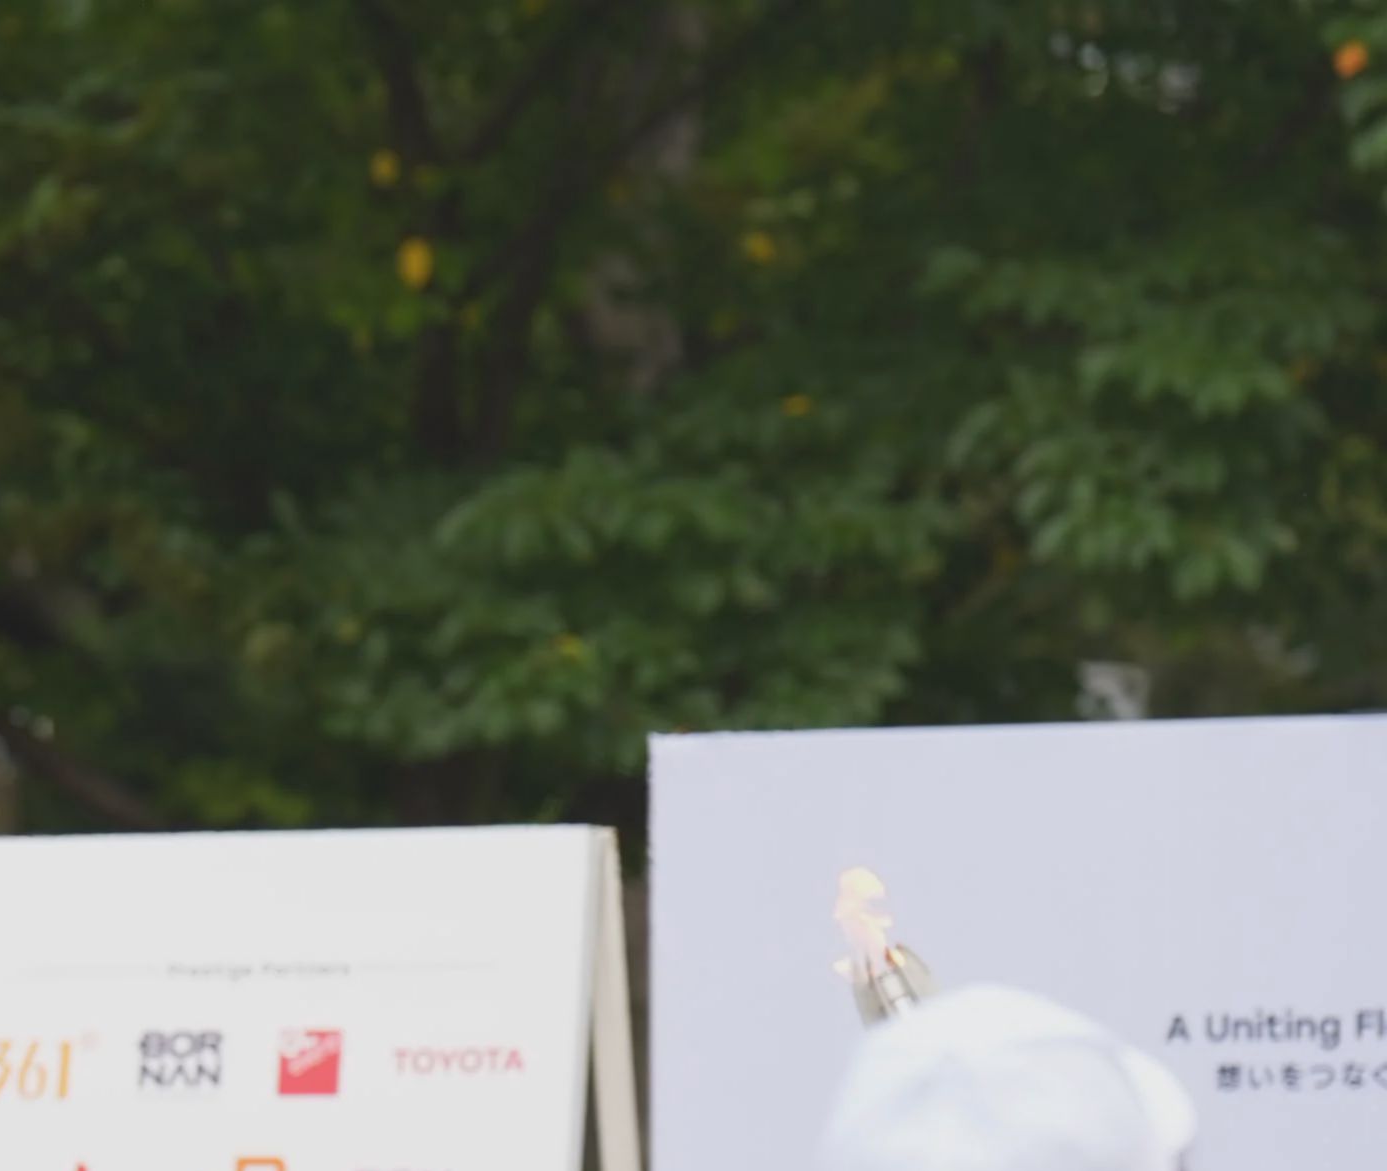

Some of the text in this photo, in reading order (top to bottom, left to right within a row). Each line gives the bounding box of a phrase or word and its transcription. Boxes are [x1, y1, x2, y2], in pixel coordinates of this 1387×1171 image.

[139, 1030, 223, 1057] BOR
[1166, 1015, 1190, 1043] A
[1205, 1008, 1340, 1051] Uniting
[394, 1047, 524, 1075] TOYOTA
